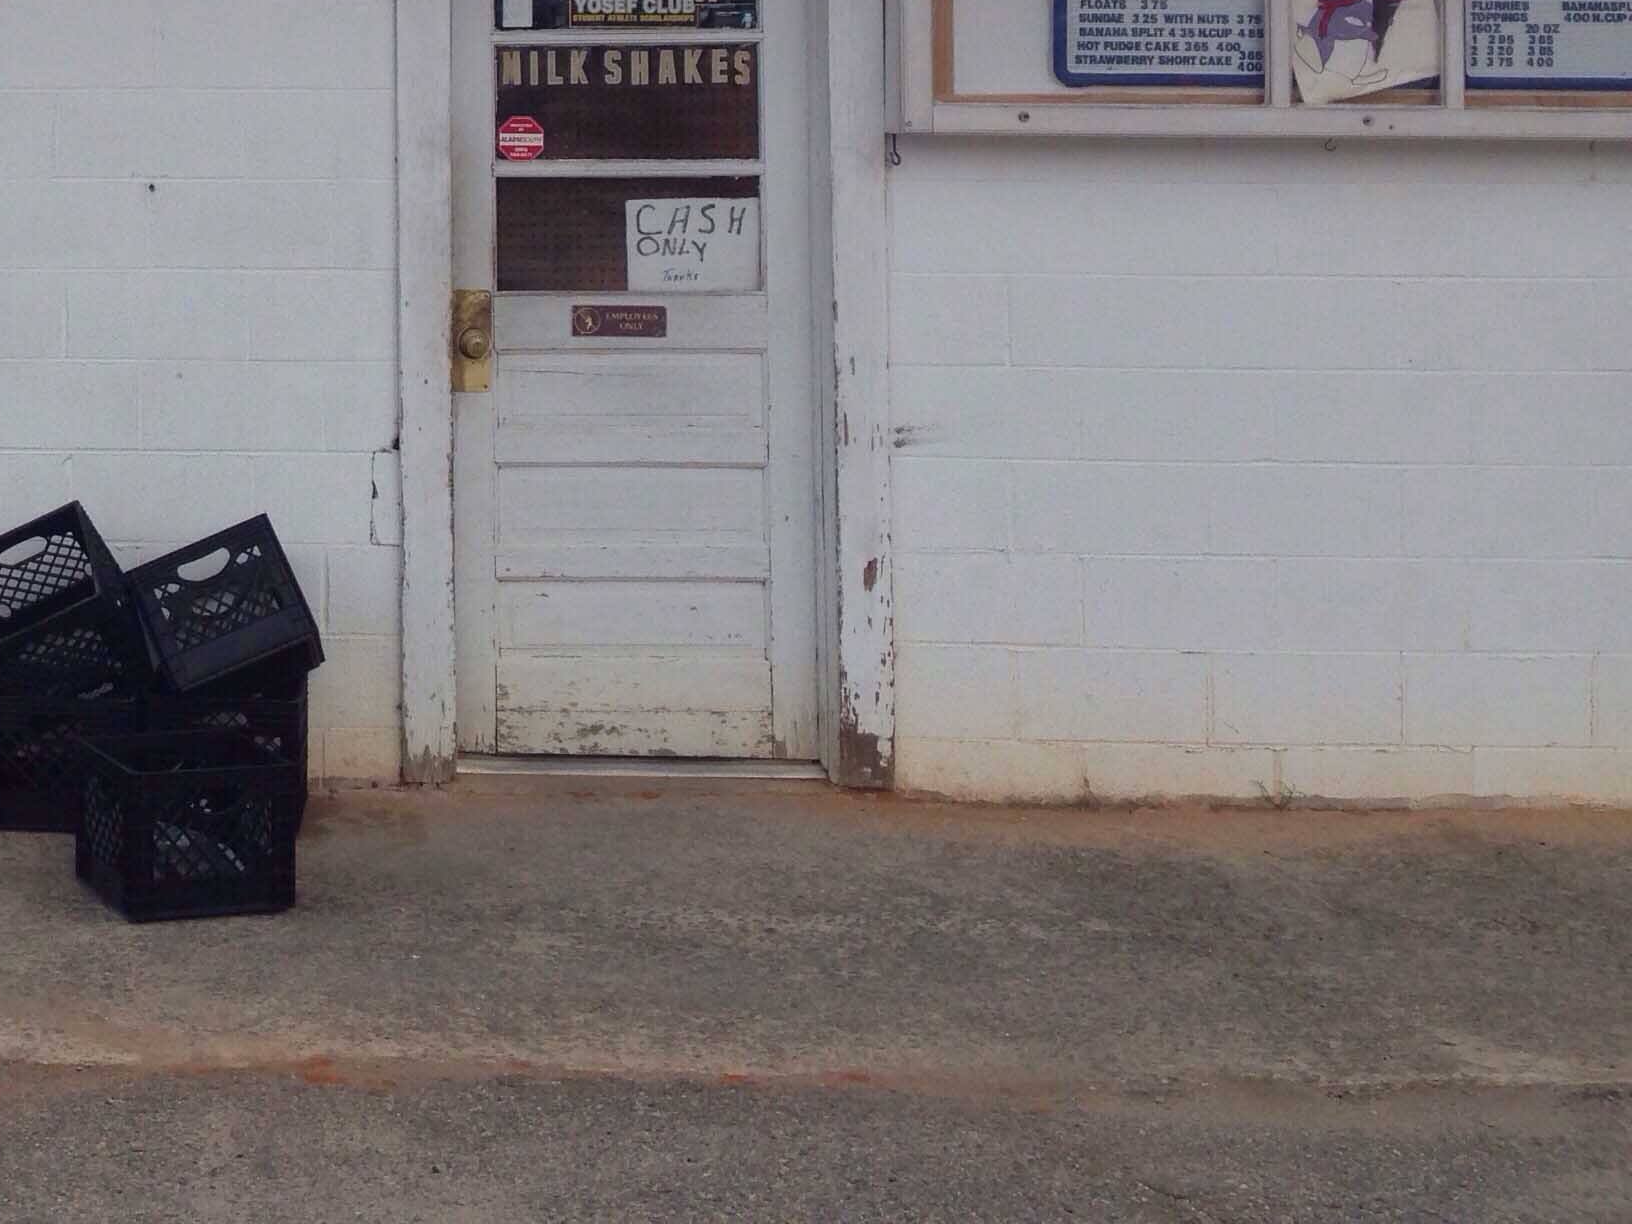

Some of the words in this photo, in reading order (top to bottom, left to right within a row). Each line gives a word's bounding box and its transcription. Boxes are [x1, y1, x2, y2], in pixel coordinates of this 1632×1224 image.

[1080, 0, 1127, 9] FLOATS
[1164, 14, 1193, 24] WITH
[1197, 14, 1229, 24] NUTS
[1079, 27, 1128, 37] BANANA
[1131, 27, 1165, 37] SPLIT
[1077, 41, 1101, 50] HOT
[1103, 41, 1141, 50] FUDGE
[1145, 41, 1179, 51] CAKE
[1075, 55, 1154, 65] STRAWBERRY
[1159, 56, 1197, 65] SHORT
[1199, 56, 1232, 65] CAKE
[502, 50, 589, 85] MILK
[604, 49, 751, 85] SHAKES
[636, 204, 746, 235] CASH
[637, 236, 706, 263] ONLY
